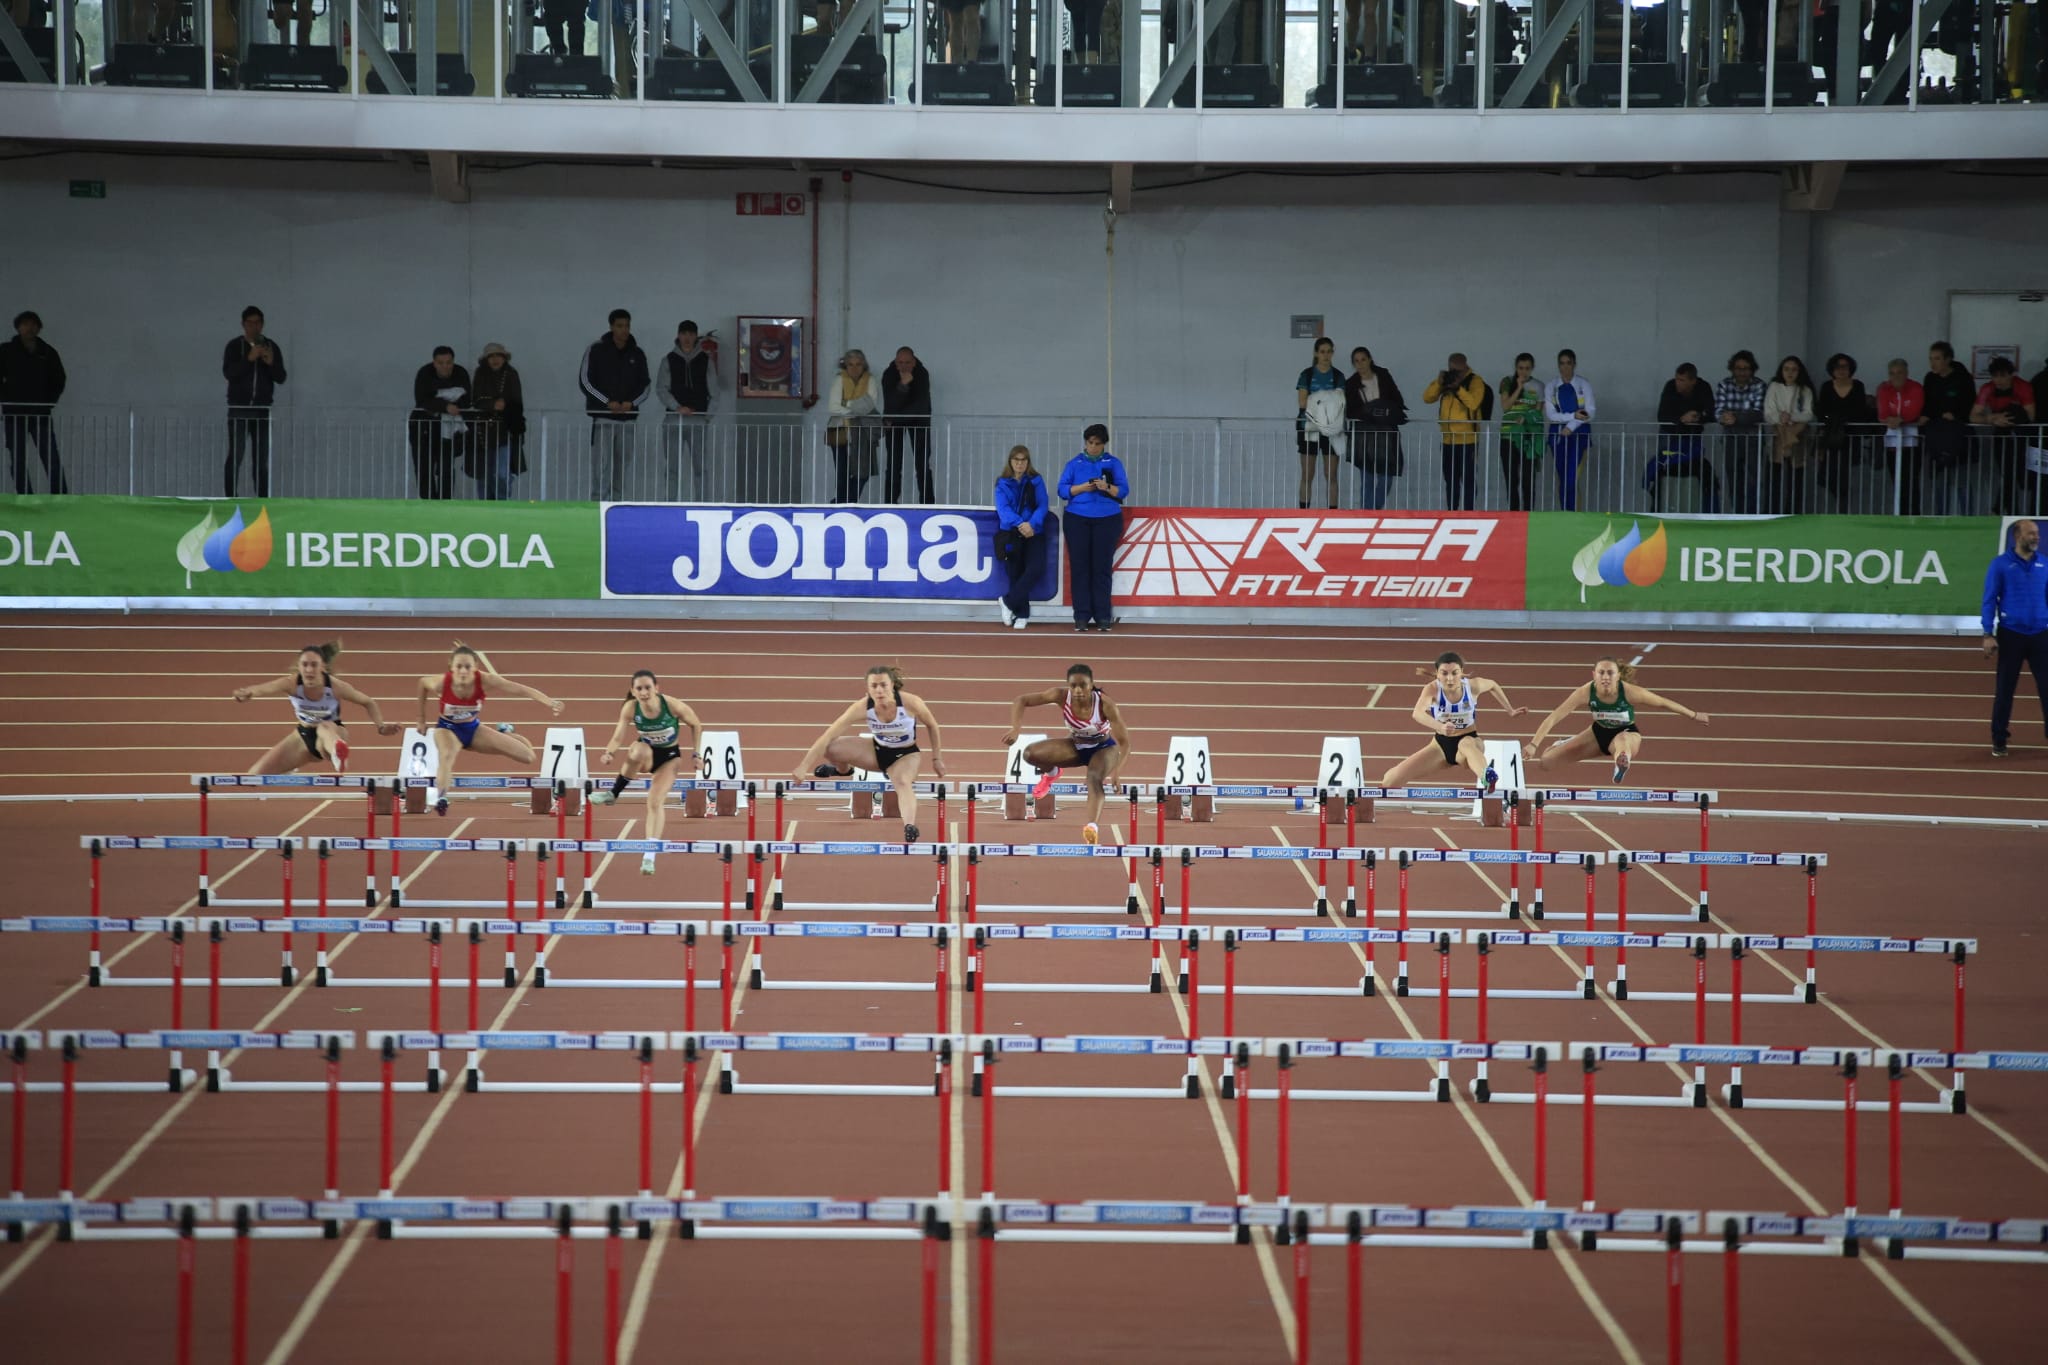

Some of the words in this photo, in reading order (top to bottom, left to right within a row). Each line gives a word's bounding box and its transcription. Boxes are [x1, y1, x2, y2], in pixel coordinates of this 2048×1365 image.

[286, 532, 555, 568] IBERDROLA
[672, 510, 992, 590] Joma
[1243, 517, 1499, 572] RFEA
[1680, 547, 1949, 585] IBERDROLA
[1229, 574, 1473, 598] ATLETISMO
[551, 744, 564, 777] 7
[703, 746, 713, 779] 6
[725, 746, 736, 779] 6
[1010, 749, 1022, 783] 4
[1172, 752, 1185, 785] 3
[1196, 750, 1206, 784] 3
[1328, 752, 1344, 787] 2
[1511, 753, 1518, 788] 1
[1257, 848, 1291, 857] SALAMANCA
[1474, 852, 1507, 860] SALAMANCA
[1308, 931, 1348, 940] SALAMANCA
[1562, 935, 1602, 944] SALAMANCA
[1818, 940, 1856, 950] SALAMANCA
